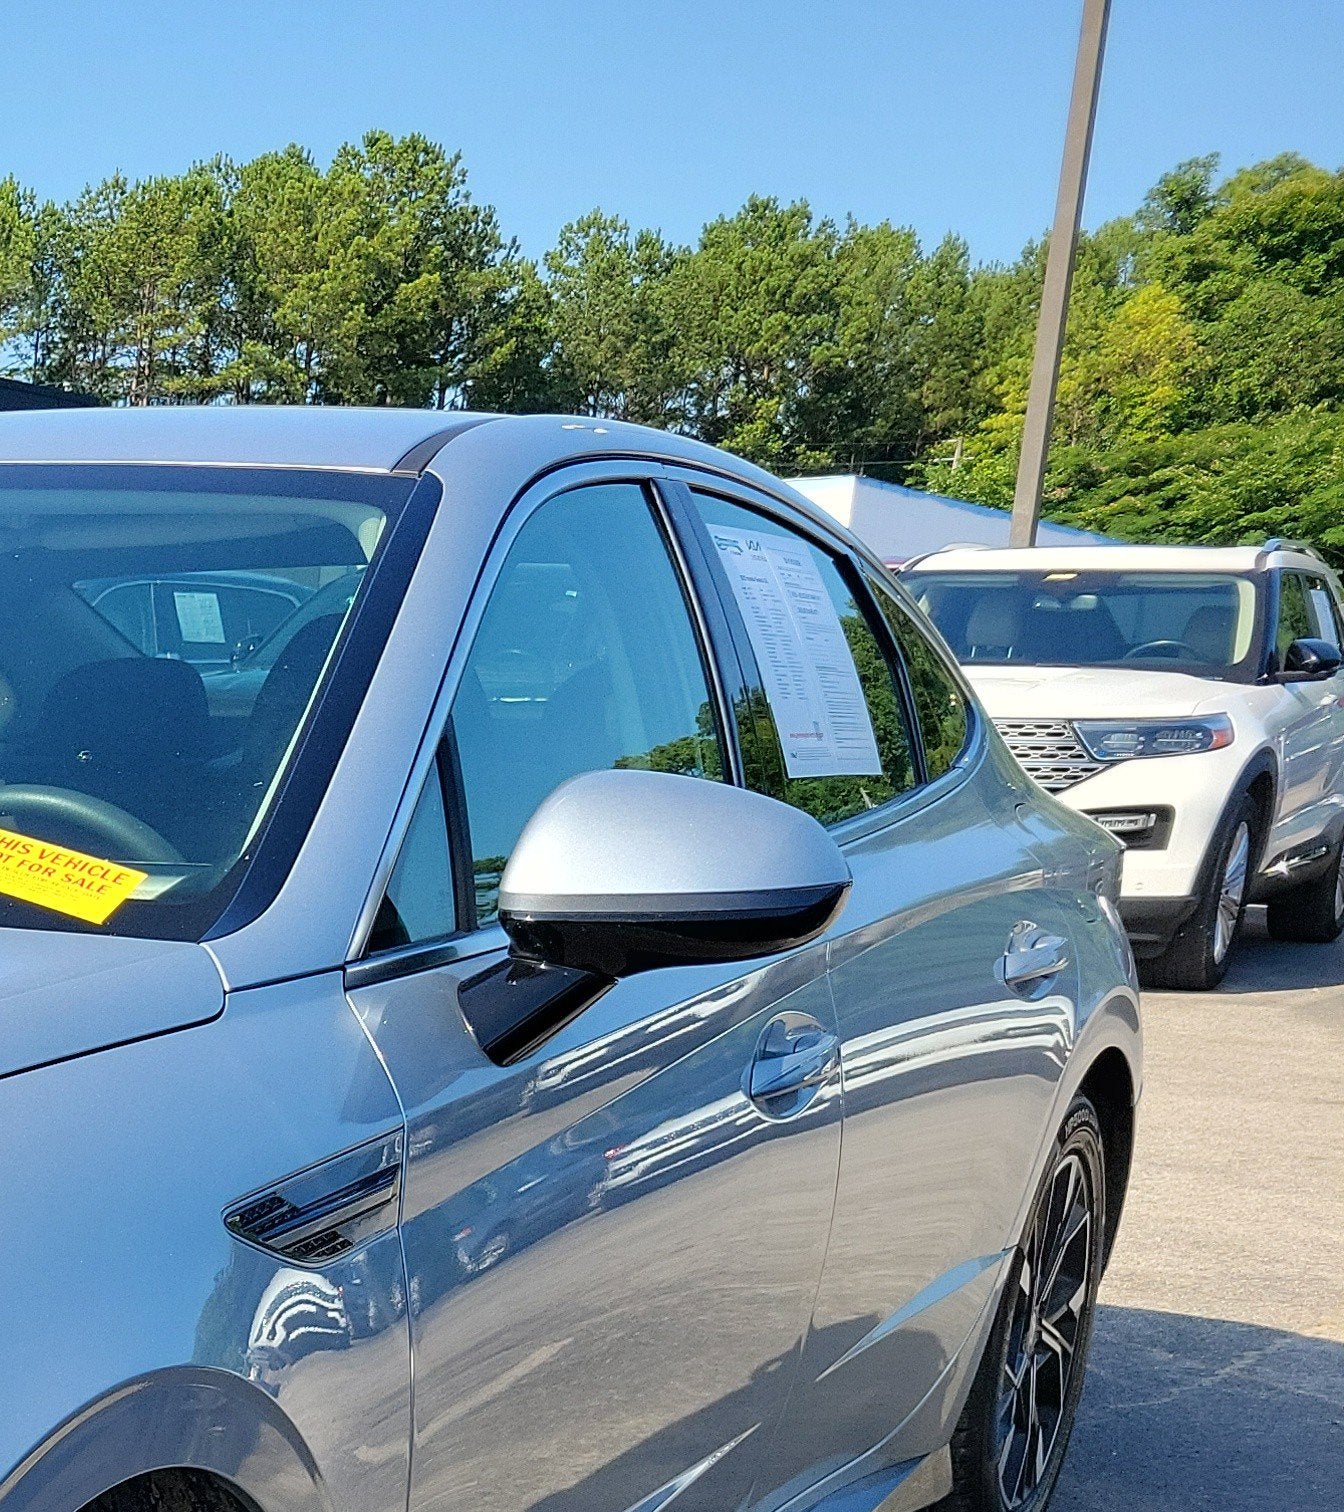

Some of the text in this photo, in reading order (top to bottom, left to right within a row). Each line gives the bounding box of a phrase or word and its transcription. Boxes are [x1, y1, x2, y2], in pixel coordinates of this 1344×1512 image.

[18, 859, 57, 878] FOR
[63, 873, 112, 895] SALE
[38, 848, 131, 886] VEHICLE
